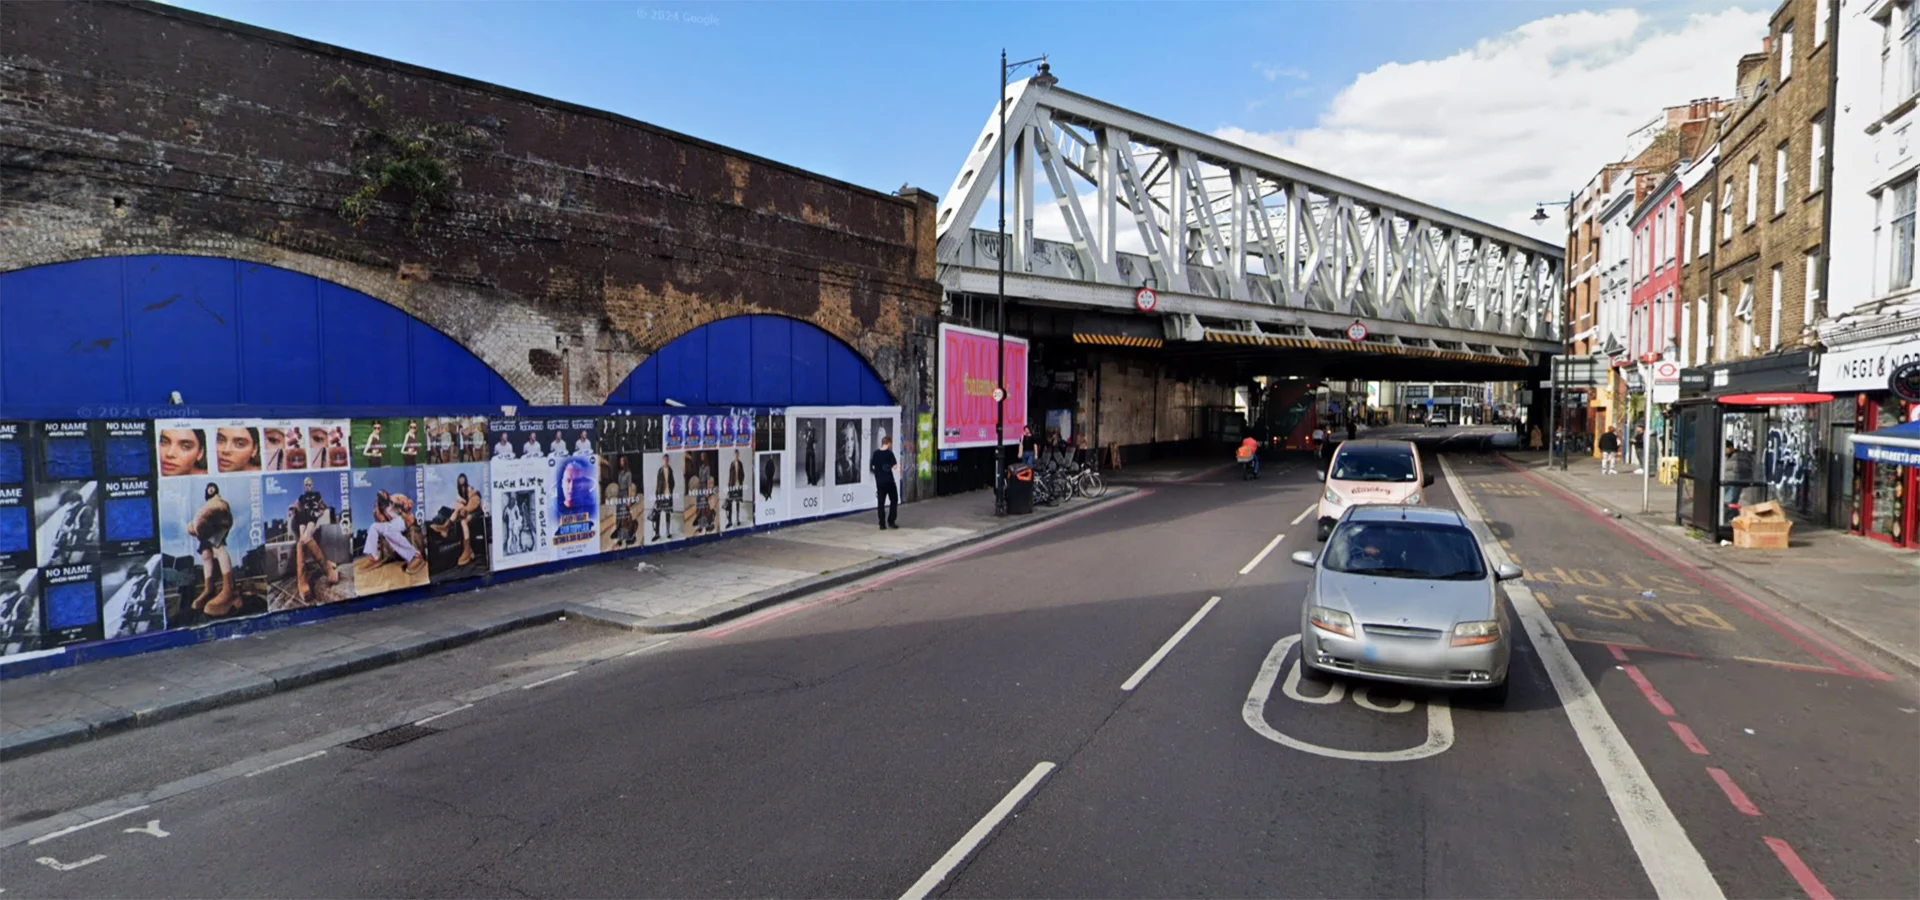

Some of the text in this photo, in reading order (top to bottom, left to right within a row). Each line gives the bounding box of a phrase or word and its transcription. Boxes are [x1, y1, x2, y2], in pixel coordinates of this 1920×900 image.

[1877, 355, 1885, 377] &
[45, 422, 88, 431] NO NAME
[106, 422, 147, 431] NO NAME
[416, 467, 424, 487] FEELS
[106, 481, 149, 491] NO NAME
[416, 488, 424, 503] LIKE
[340, 472, 351, 535] FEELS LIKE UGG
[803, 497, 818, 509] COS
[46, 565, 92, 578] NO NAME
[1575, 593, 1738, 632] BUS
